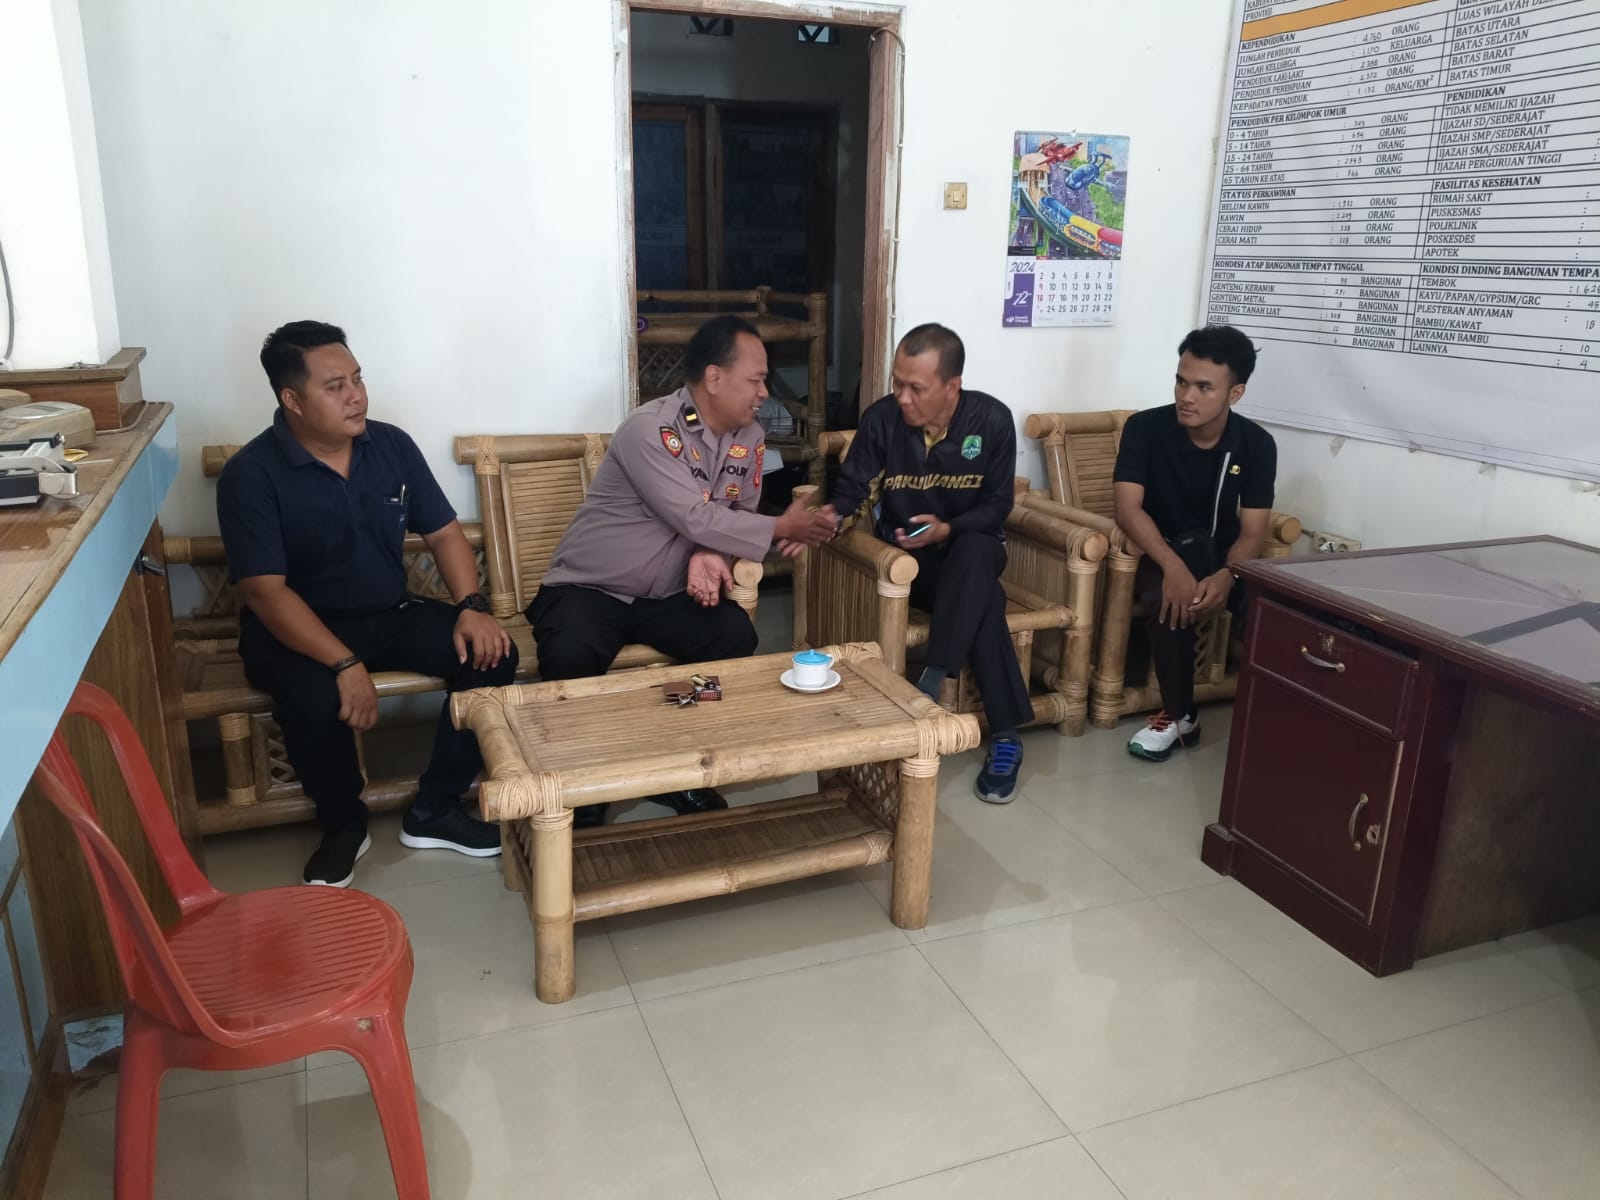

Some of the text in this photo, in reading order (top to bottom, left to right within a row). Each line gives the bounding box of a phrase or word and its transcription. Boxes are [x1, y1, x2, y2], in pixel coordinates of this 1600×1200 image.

[1458, 8, 1481, 21] LUAS
[1483, 0, 1529, 16] WILAYAH
[1456, 16, 1520, 37] BATAS UTARA
[1239, 52, 1265, 64] JUMLAH
[1392, 22, 1419, 35] ORANG
[1454, 29, 1529, 51] BATAS SELATAN
[1237, 64, 1264, 77] JUMLAH
[1390, 34, 1432, 50] KELUARGA
[1388, 50, 1416, 63] ORANG
[1452, 47, 1516, 66] BATAS BARAT
[1386, 65, 1414, 77] ORANG
[1450, 64, 1511, 81] BATAS TIMUR
[1447, 86, 1506, 102] PENDIDIKAN
[1445, 94, 1555, 116] TIDAK MEMILIKI IJAZAH
[1231, 107, 1347, 127] PENDUDUK PER KELOMPOK UMUR
[1443, 110, 1545, 131] IJAZAH SD/SEDERAJAT
[1247, 128, 1269, 138] TAHUN
[1381, 113, 1408, 124] ORANG
[1240, 142, 1248, 150] 14
[1249, 140, 1271, 149] TAHUN
[1379, 126, 1406, 137] ORANG
[1441, 124, 1551, 144] IJAZAH SMP/SEDERAJAT
[1227, 140, 1405, 162] 15 24 TAHUN ORANG
[1439, 140, 1549, 158] IJAZAH SMA/SEDERAJAT
[1225, 153, 1403, 173] 25 64 TAHUN ORANG
[1437, 153, 1561, 171] IJAZAH PERGURUAN TINGGI
[1224, 176, 1232, 184] 65
[1234, 175, 1259, 184] TAHUN
[1374, 166, 1401, 175] ORANG
[1434, 176, 1541, 190] FASILITAS KESEHATAN
[1222, 190, 1251, 200] STATUS
[1432, 193, 1493, 203] RUMAH SAKIT
[1221, 197, 1397, 211] BELUM KAWIN ORANG
[1220, 210, 1395, 222] KAWIN ORANG
[1431, 207, 1481, 217] PUSKESMAS
[1240, 225, 1262, 233] HIDUP
[1366, 223, 1393, 232] ORANG
[1429, 221, 1478, 230] POLIKLINIK
[1364, 236, 1391, 244] ORANG
[1427, 234, 1476, 244] POSKESDES
[1425, 248, 1459, 257] APOTEK
[1009, 262, 1036, 273] 2024
[1215, 261, 1364, 272] KONDISI ATAP BANGUNAN TEMPAT TINGGAL
[1422, 264, 1460, 274] KONDISI
[1461, 265, 1501, 275] DINDING
[1503, 266, 1559, 277] BANGUNAN
[1213, 272, 1402, 286] BETON BANGUNAN
[1421, 278, 1456, 288] TEMBOK
[1212, 283, 1400, 298] GENTENG KERAMIK BANGUNAN
[1211, 293, 1399, 311] GENTENG METAL BANGUNAN
[1419, 291, 1541, 306] KAYU/PAPAN/GYPSUM/GRC
[1210, 305, 1398, 324] GENTENG TANAH LIAT BANGUNAN
[1417, 304, 1513, 319] PLESTERAN ANYAMAN
[1208, 315, 1396, 336] ASBES BANGUNAN
[1415, 317, 1482, 330] BAMBU/KAWAT
[1352, 337, 1395, 349] BANGUNAN
[1414, 330, 1456, 341] ANYAMAN
[1457, 333, 1489, 344] BAMBU
[1412, 342, 1448, 354] LAINNYA
